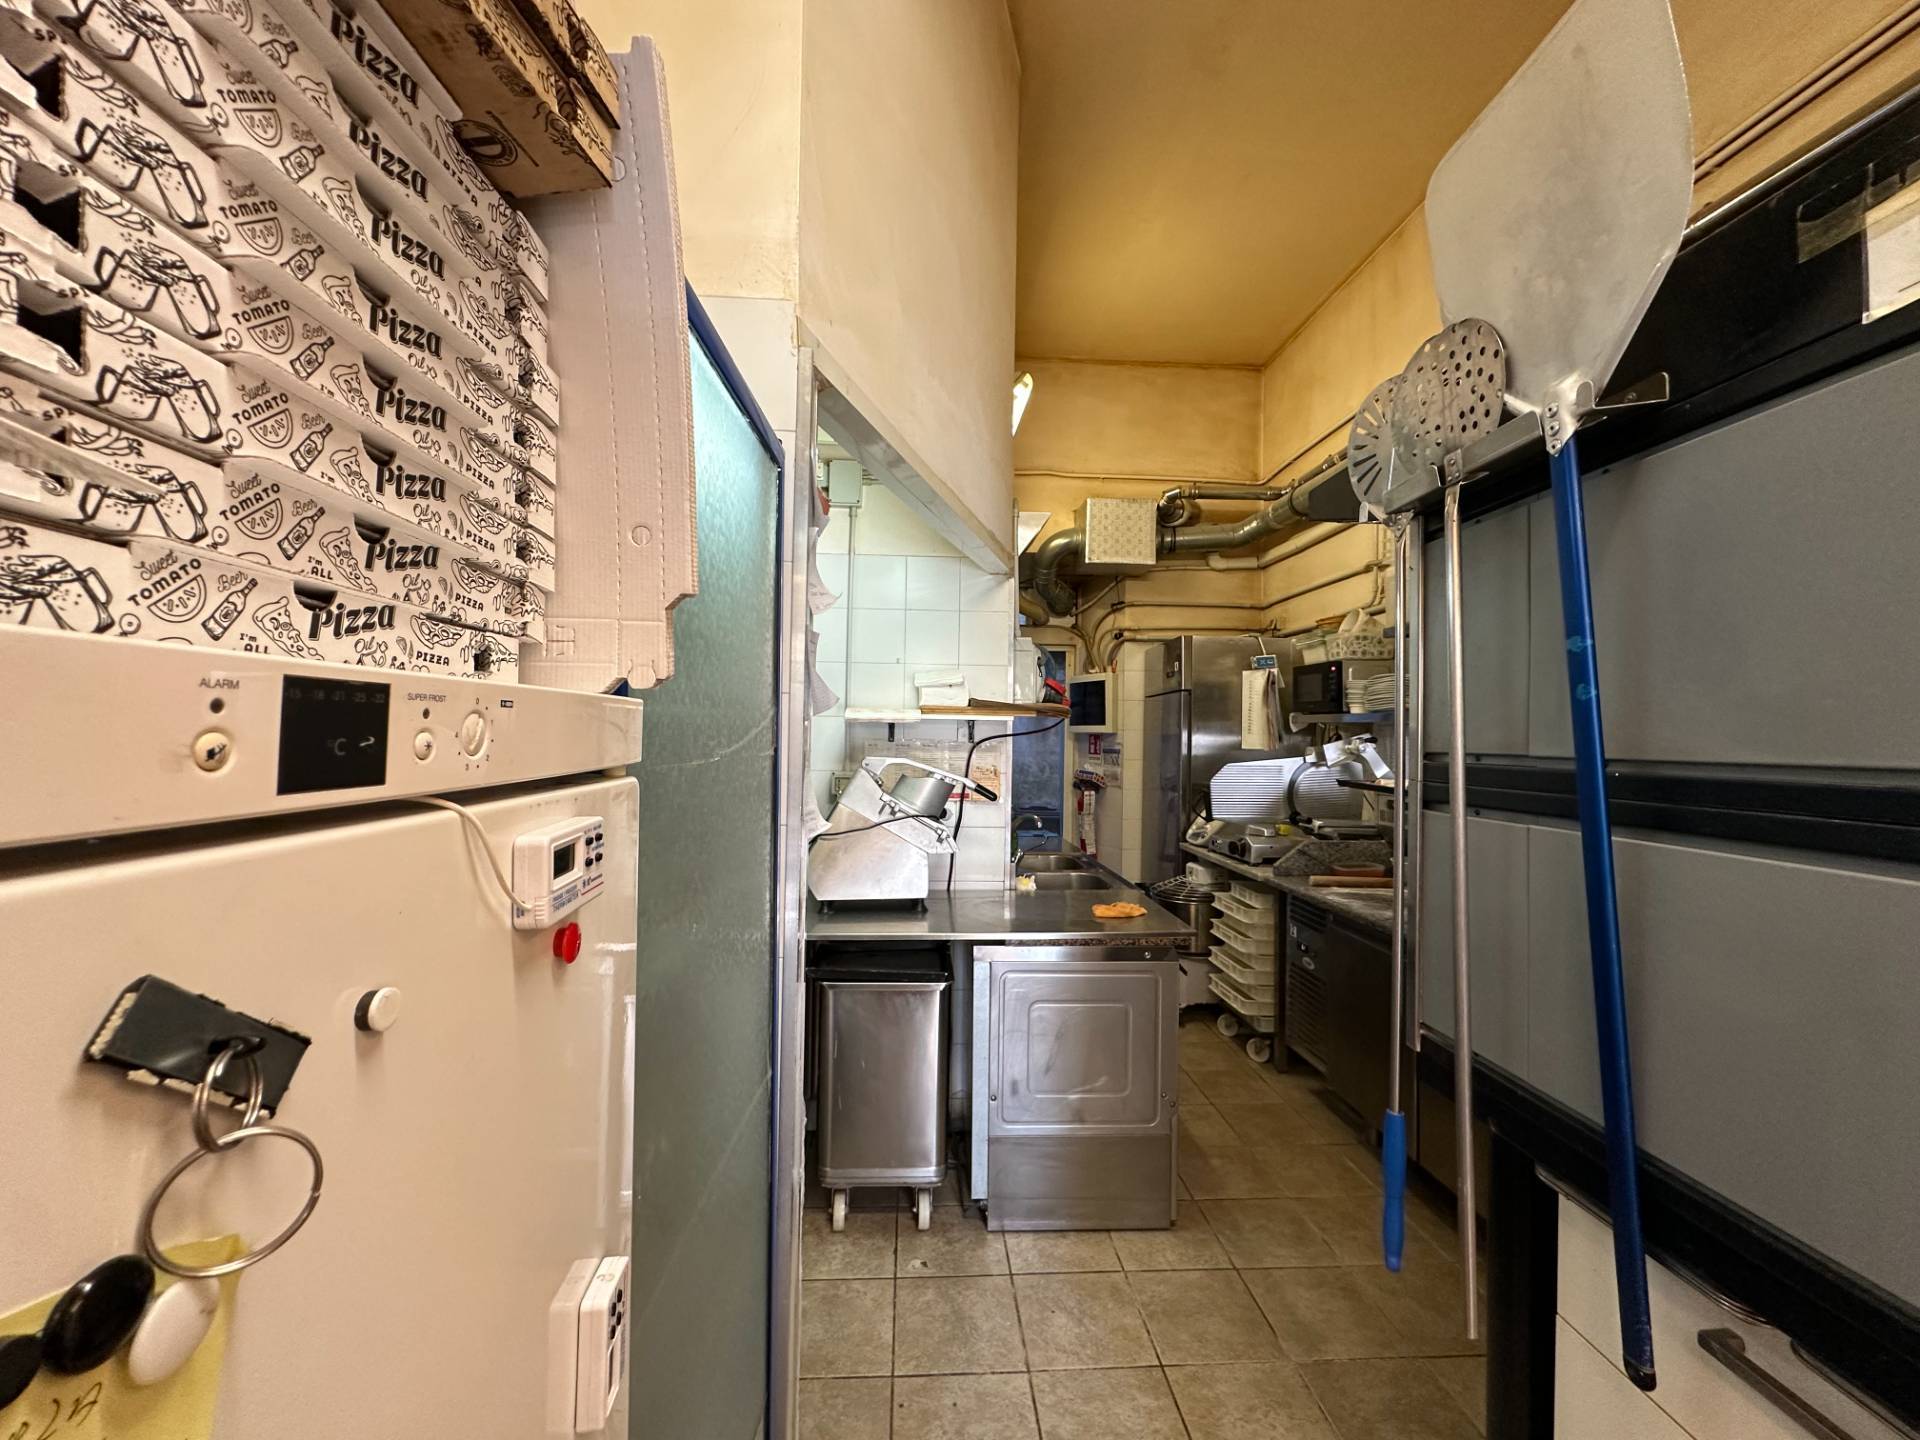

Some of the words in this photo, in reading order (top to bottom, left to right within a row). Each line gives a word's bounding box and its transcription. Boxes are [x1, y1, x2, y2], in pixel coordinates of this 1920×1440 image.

[331, 10, 418, 109] Pizza
[217, 88, 276, 104] TOMATO
[349, 120, 428, 202] Pizza
[219, 200, 278, 219] TOMATO
[370, 212, 446, 281] Pizza
[232, 300, 290, 325] TOMATO
[302, 323, 326, 340] Beer
[369, 303, 443, 360] Pizza
[408, 352, 425, 368] Oil
[237, 379, 271, 403] Sweet
[232, 393, 289, 424] TOMATO
[376, 388, 447, 433] Pizza
[463, 394, 494, 426] PIZZA
[301, 413, 325, 430] Beer
[413, 429, 430, 444] Oil
[226, 473, 261, 499] Sweet
[376, 464, 446, 502] Pizza
[465, 464, 495, 489] PIZZA
[219, 483, 280, 521] TOMATO
[291, 499, 318, 517] Beer
[413, 503, 430, 517] Oil
[465, 529, 496, 552] PIZZA
[133, 550, 178, 580] Sweet
[364, 538, 440, 573] Pizza
[128, 558, 201, 606] TOMATO
[217, 571, 248, 593] Beer
[311, 567, 334, 581] ALL
[403, 573, 420, 588] Oil
[455, 592, 484, 611] PIZZA
[308, 602, 396, 641] Pizza
[240, 632, 257, 643] I'm
[354, 636, 374, 653] Oil
[244, 643, 271, 655] ALL
[416, 650, 450, 667] PIZZA
[199, 678, 240, 689] ALARM
[408, 692, 428, 701] SUPER
[429, 695, 447, 703] FROST
